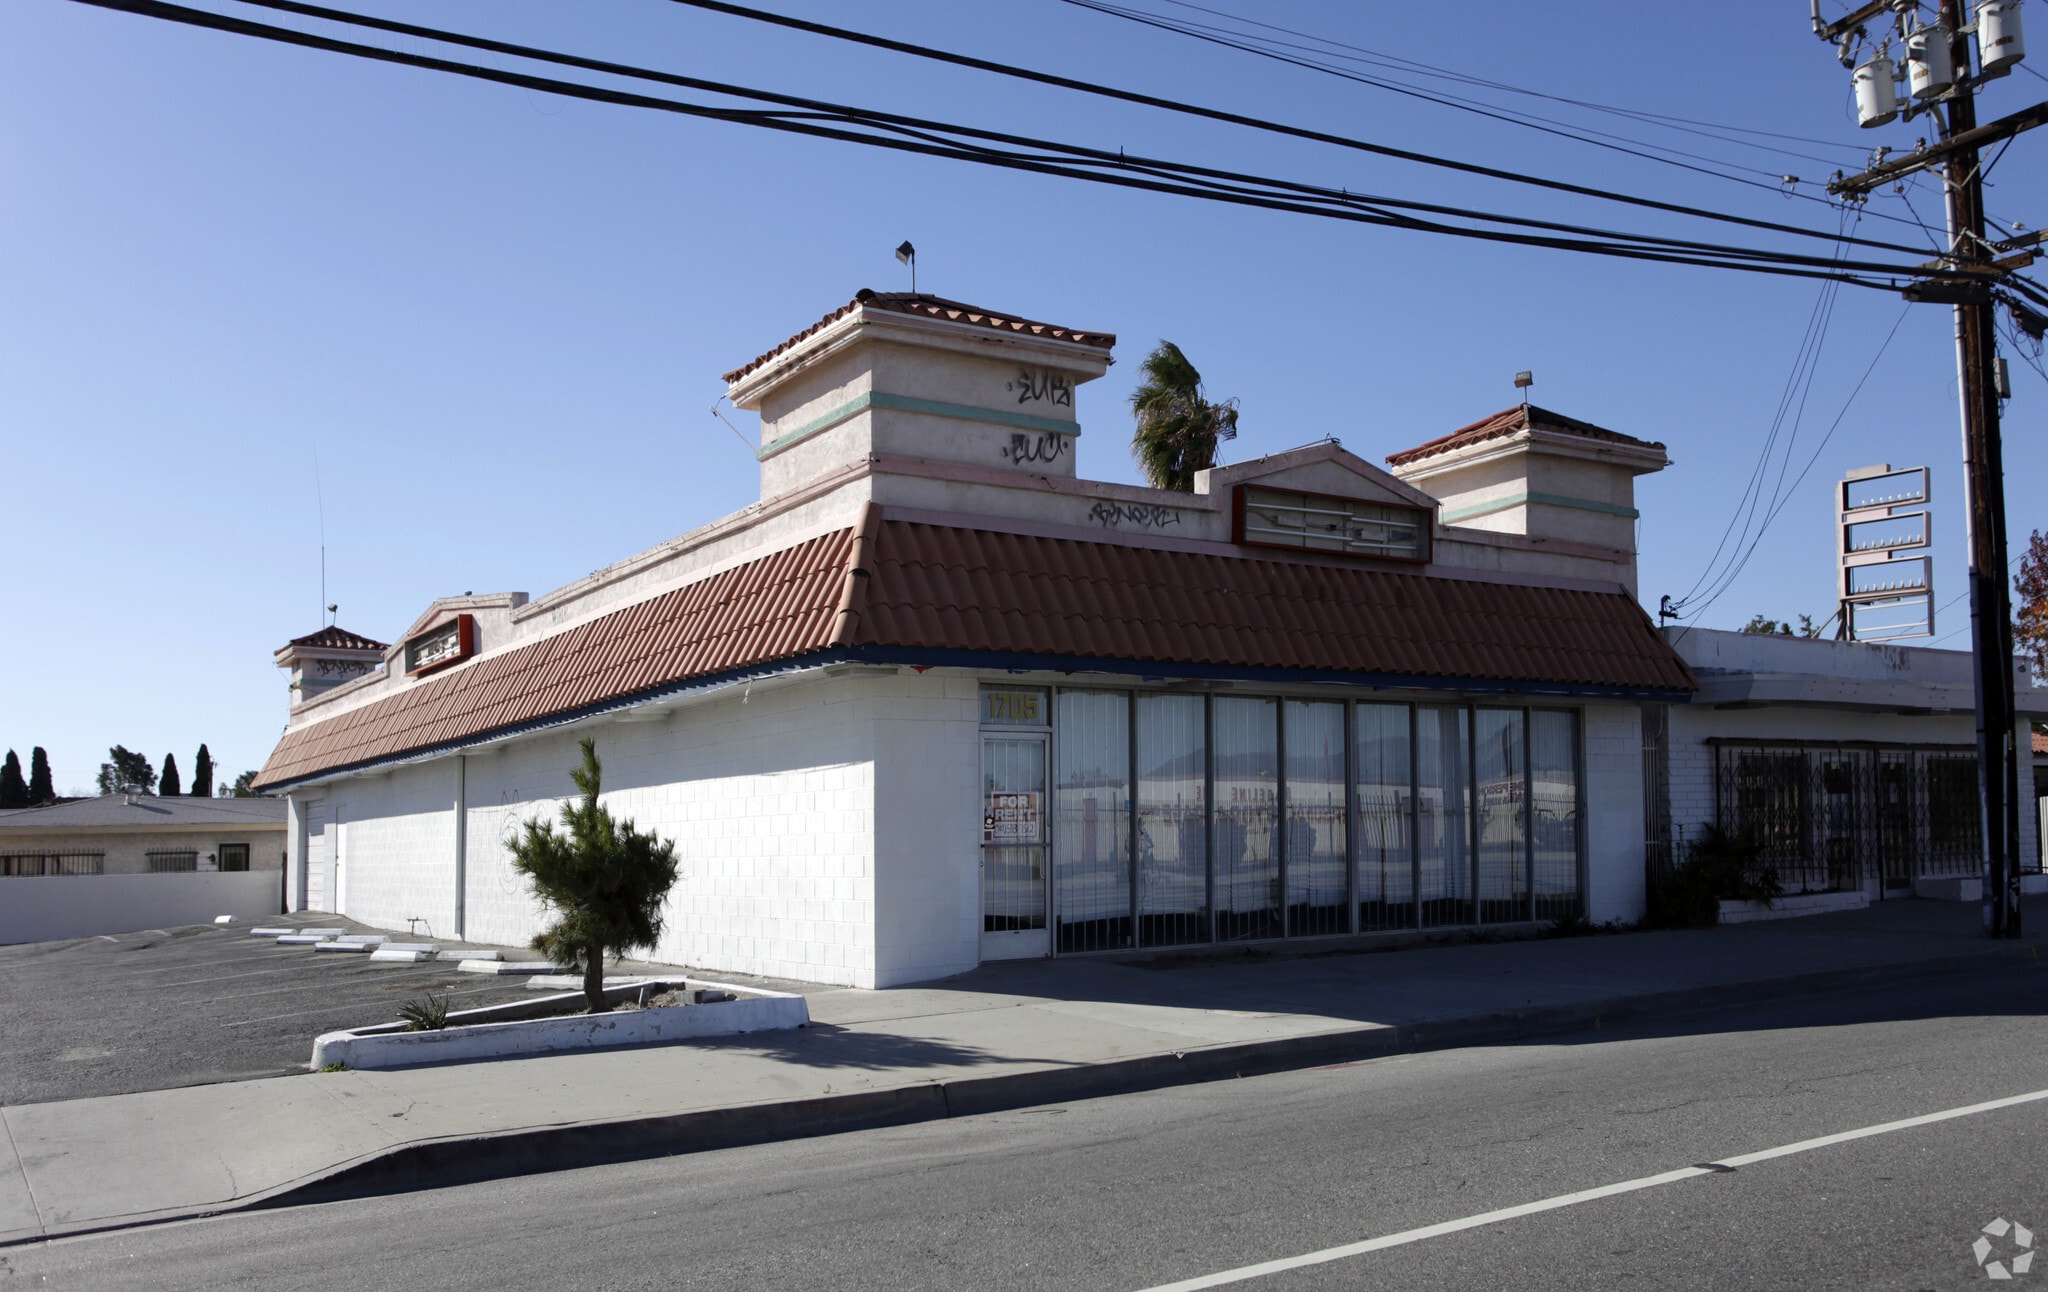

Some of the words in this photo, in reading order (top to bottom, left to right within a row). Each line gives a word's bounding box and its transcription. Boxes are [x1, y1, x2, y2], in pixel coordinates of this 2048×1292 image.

[988, 693, 1038, 719] 1705
[1000, 795, 1028, 808] FOR
[995, 808, 1033, 821] RENT
